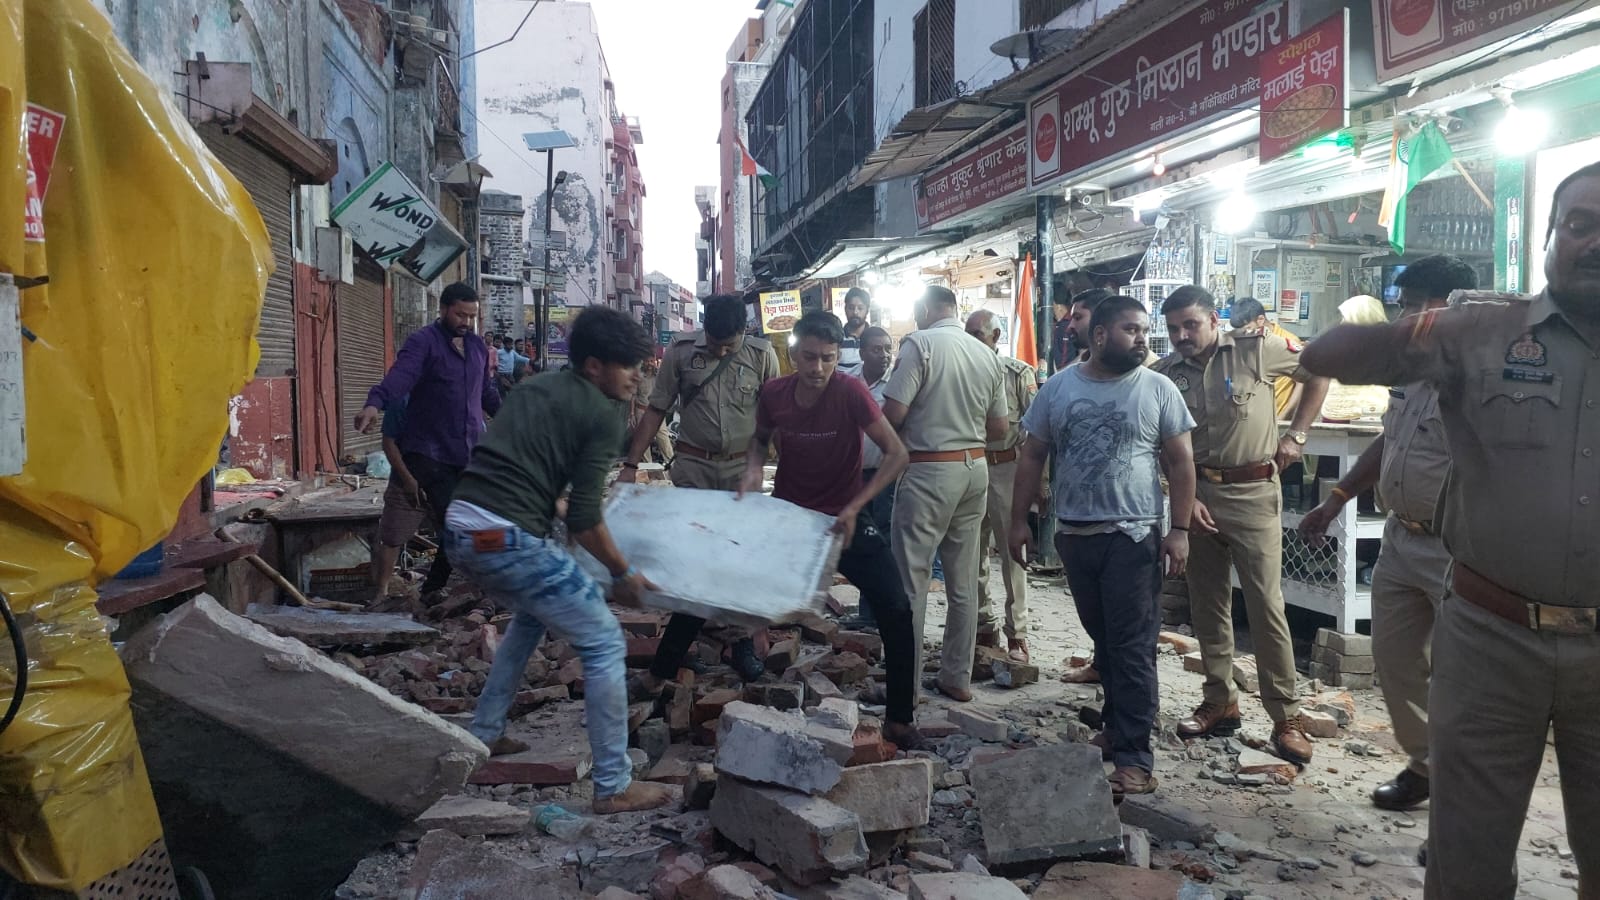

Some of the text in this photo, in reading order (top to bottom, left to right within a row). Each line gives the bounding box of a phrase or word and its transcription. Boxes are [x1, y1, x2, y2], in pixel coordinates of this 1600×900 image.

[1278, 31, 1322, 66] स्पेशल
[1063, 96, 1100, 143] शम्भू
[1100, 79, 1131, 138] गुरु
[1136, 41, 1203, 109] मिष्ठान
[1212, 2, 1284, 71] भण्डार
[1263, 45, 1339, 101] मलाई पेड़ा
[26, 111, 55, 138] ER
[950, 163, 974, 192] मुकुट
